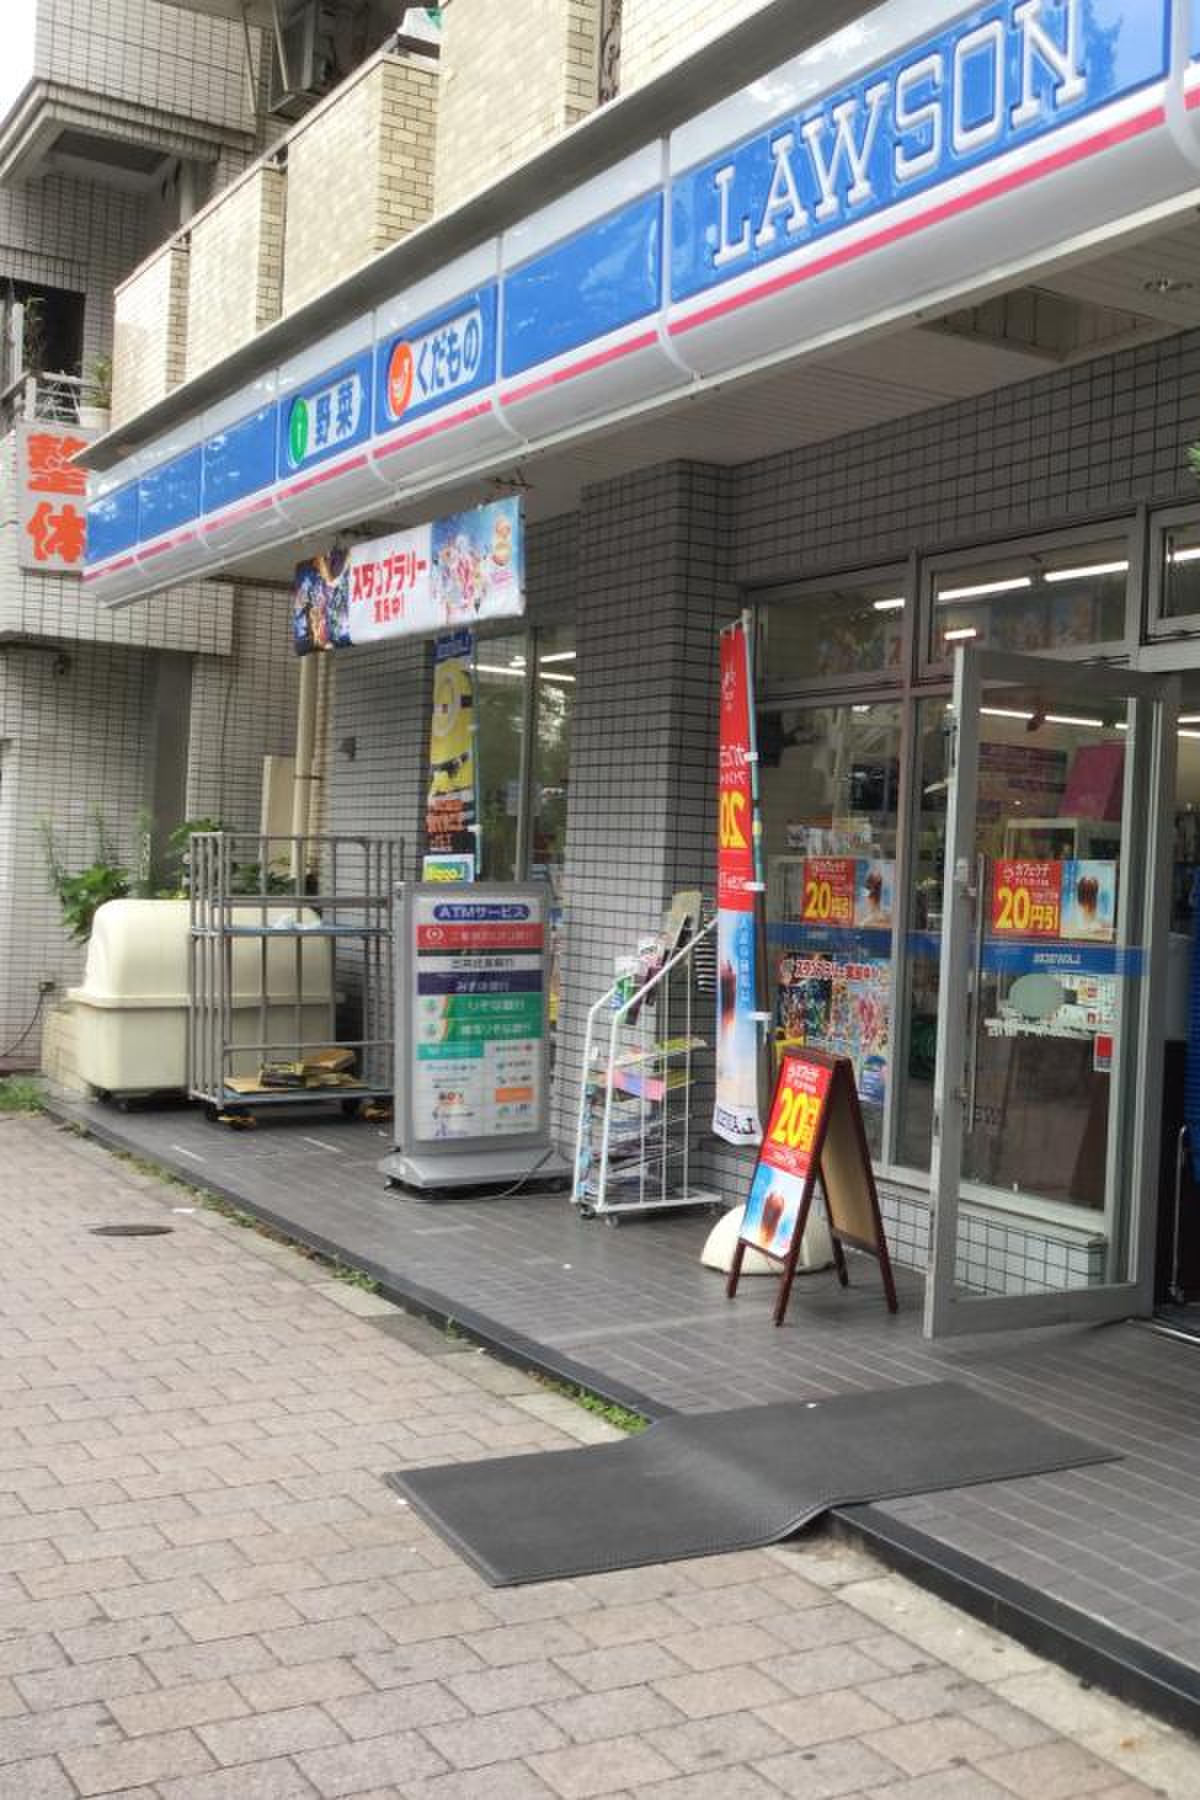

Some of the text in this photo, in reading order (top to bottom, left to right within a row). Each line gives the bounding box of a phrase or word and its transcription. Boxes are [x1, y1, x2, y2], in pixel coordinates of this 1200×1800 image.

[713, 0, 1086, 267] LAWSON
[417, 318, 479, 396] くだもの
[315, 383, 353, 446] 野菜
[27, 433, 88, 562] 整体
